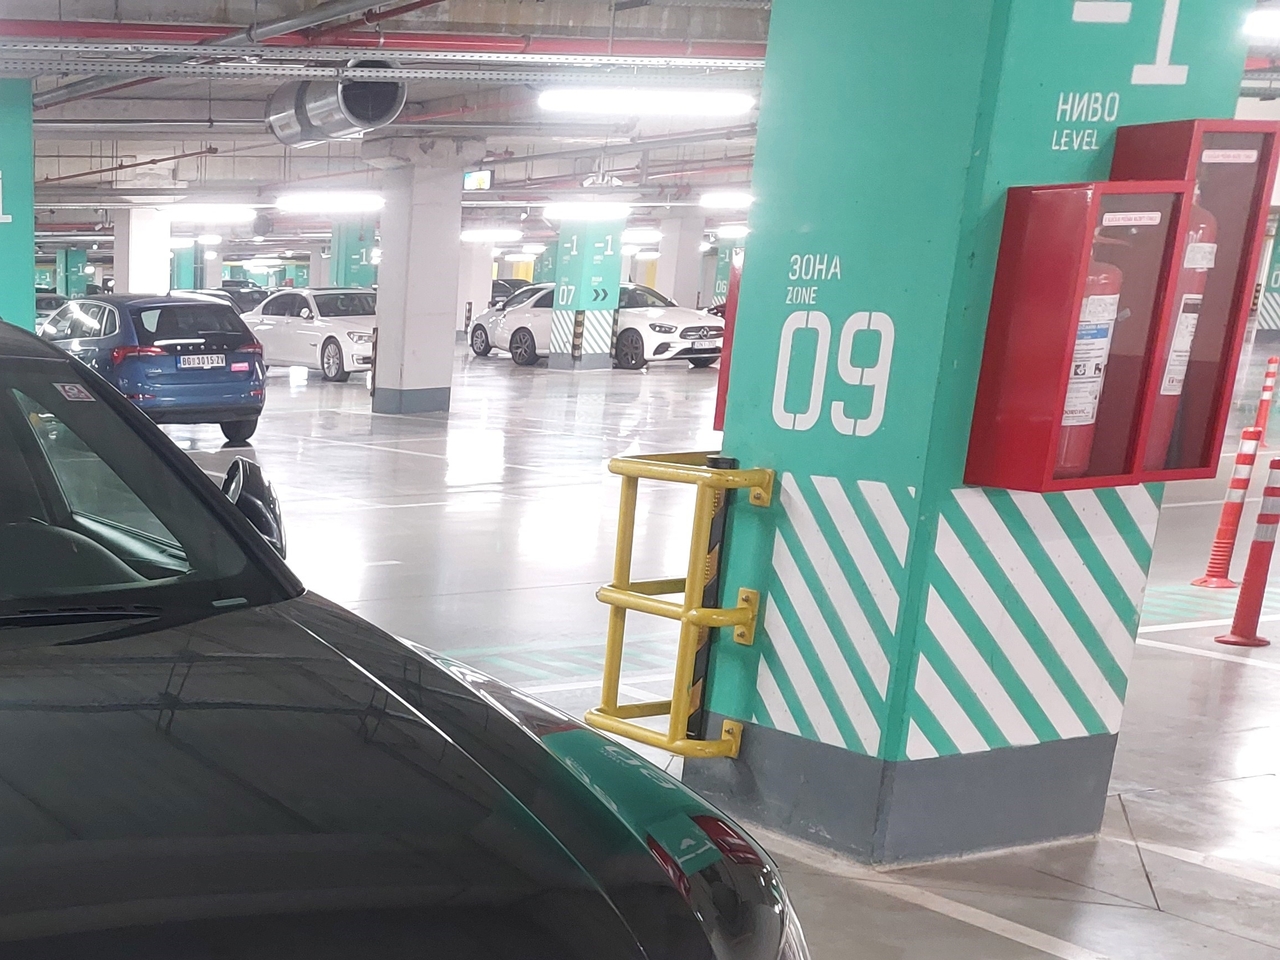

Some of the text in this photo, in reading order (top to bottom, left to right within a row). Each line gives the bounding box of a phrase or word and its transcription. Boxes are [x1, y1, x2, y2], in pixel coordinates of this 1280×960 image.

[1072, 0, 1189, 85] -1
[1056, 91, 1120, 122] НИВО
[1051, 129, 1100, 151] LEVEL
[563, 235, 578, 255] -1
[594, 235, 614, 255] -1
[351, 248, 368, 265] -1
[720, 249, 730, 262] -1
[71, 263, 85, 276] -1
[298, 269, 308, 279] -1
[788, 254, 842, 281] ЗОНА
[559, 285, 576, 305] 07
[715, 280, 728, 293] 06
[785, 287, 818, 305] ZONE
[772, 310, 895, 437] 09
